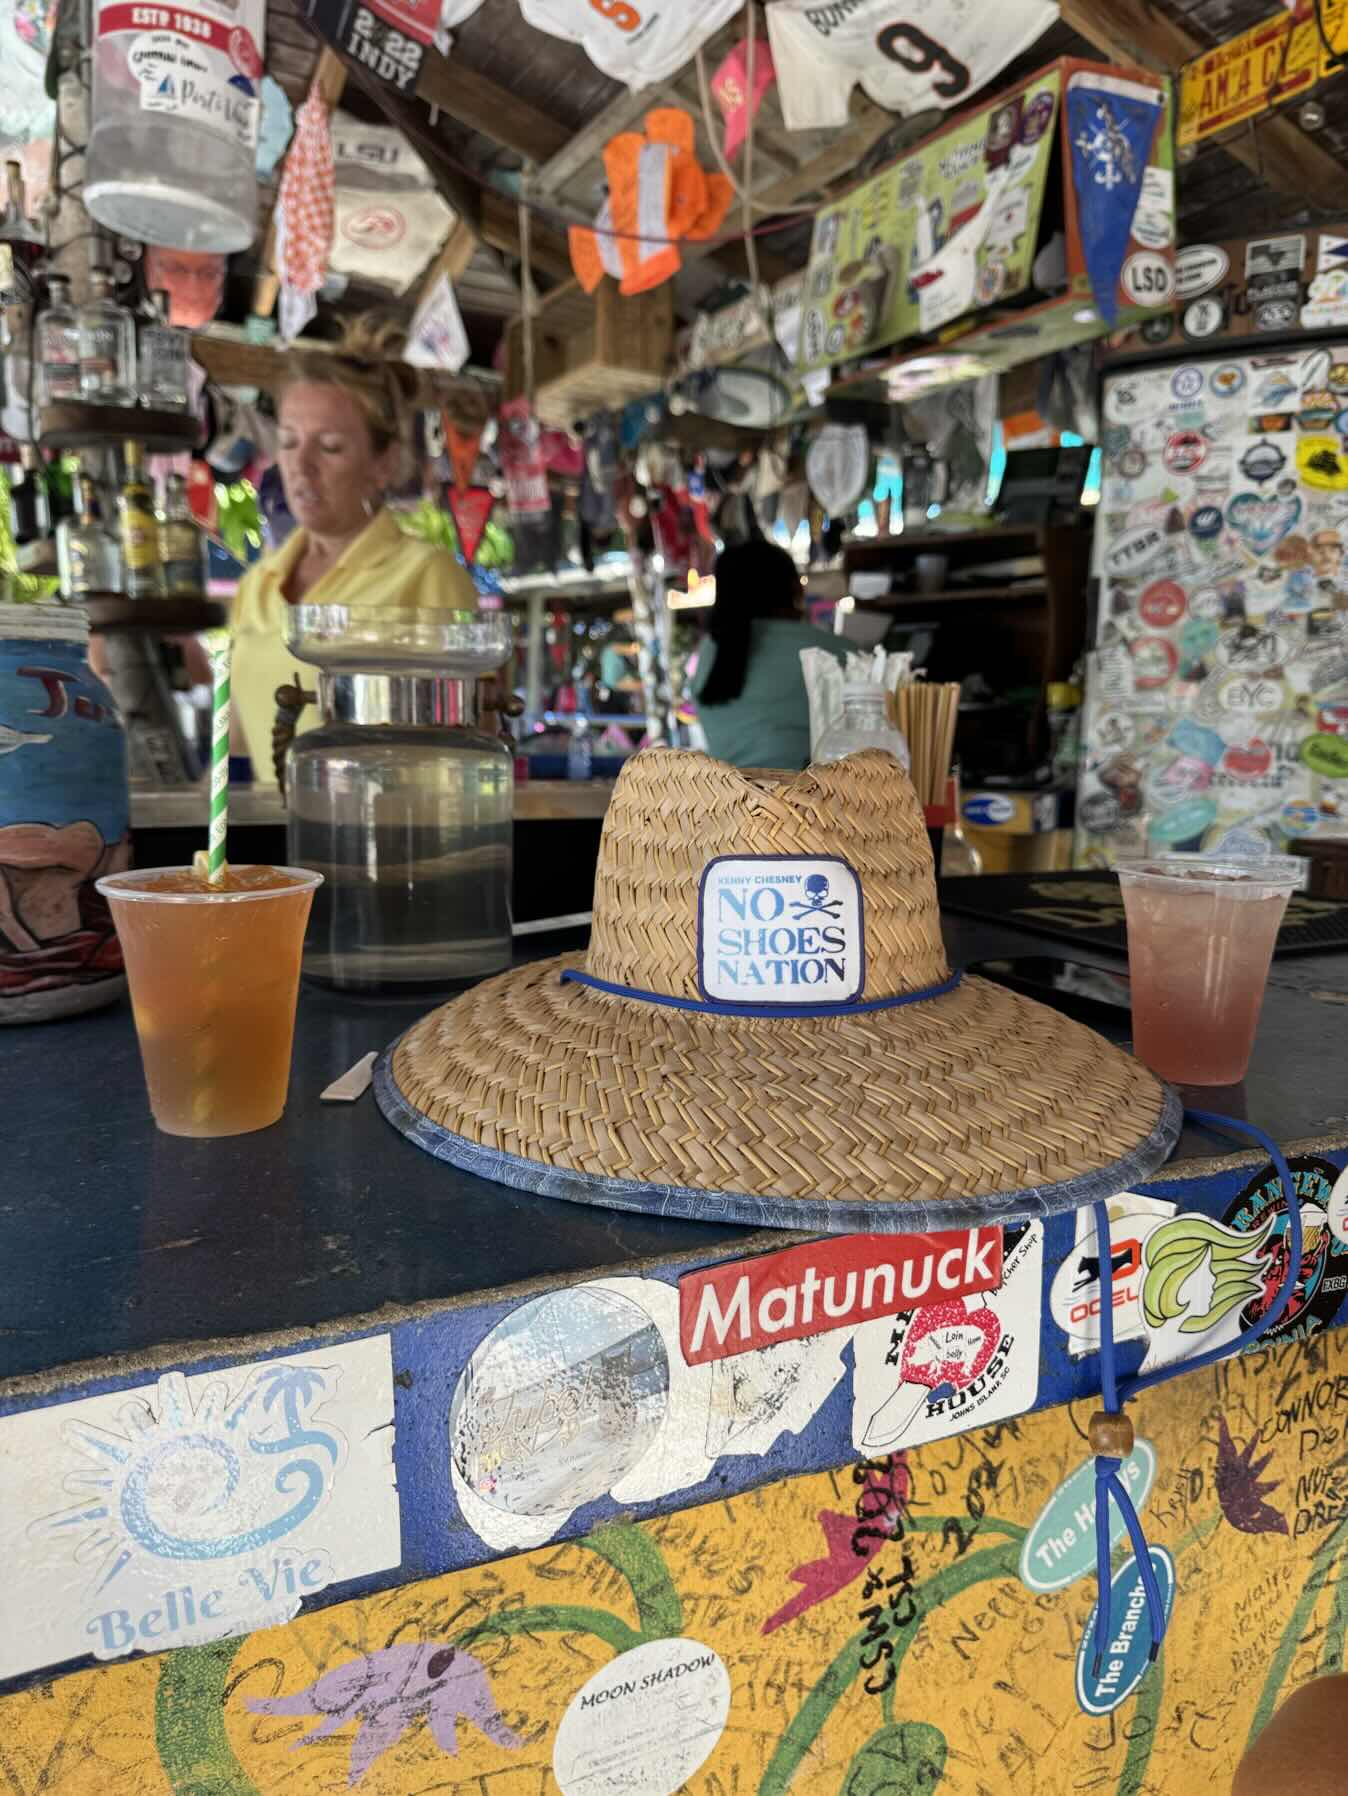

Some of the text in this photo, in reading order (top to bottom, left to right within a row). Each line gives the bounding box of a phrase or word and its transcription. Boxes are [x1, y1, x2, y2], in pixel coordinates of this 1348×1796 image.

[348, 32, 417, 90] INDY
[875, 22, 970, 98] 9
[1131, 267, 1168, 293] LSD
[718, 875, 802, 885] KENNY CHESNEY
[718, 887, 785, 922] NO
[717, 926, 846, 956] SHOES
[717, 957, 847, 986] NATION
[689, 1228, 998, 1352] Matunuck
[925, 1333, 1015, 1419] HOUSE
[1035, 1527, 1077, 1569] The
[86, 1585, 223, 1649] Belle
[240, 1558, 321, 1600] Vie
[579, 1653, 715, 1710] MOON SHADOW
[1095, 1659, 1124, 1697] The
